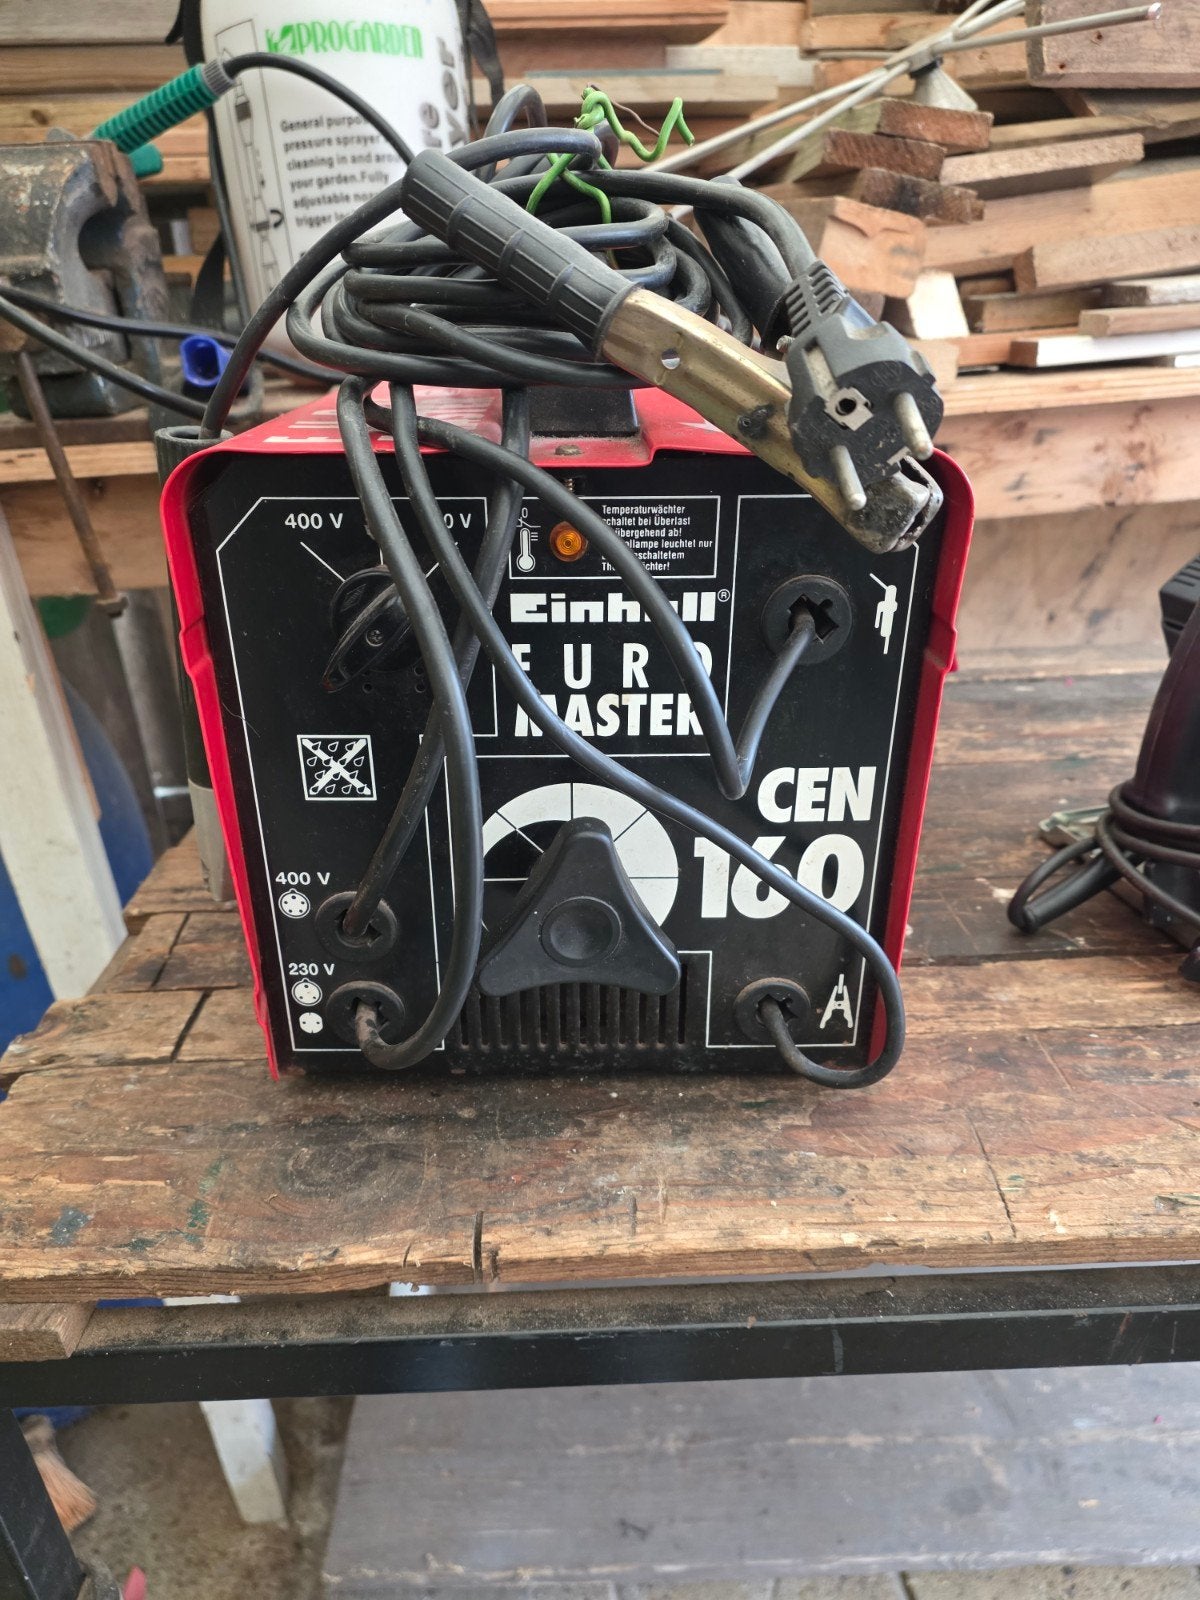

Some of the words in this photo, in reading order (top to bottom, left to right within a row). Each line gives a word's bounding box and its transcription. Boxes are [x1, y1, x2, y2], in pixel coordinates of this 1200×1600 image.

[296, 20, 423, 59] PROGARDEN
[281, 116, 324, 132] General
[284, 137, 333, 154] pressure
[287, 157, 334, 171] cleaning
[336, 154, 348, 164] in
[350, 153, 372, 164] and
[290, 179, 314, 193] your
[293, 192, 350, 209] adjustable
[295, 213, 332, 228] trigger
[602, 504, 686, 516] Temperaturwächter
[284, 513, 323, 530] 400
[330, 513, 343, 529] V
[459, 513, 472, 529] V
[638, 516, 652, 526] bei
[654, 514, 691, 526] Überlast
[668, 528, 682, 537] ab!
[661, 540, 696, 548] leuchtet
[757, 766, 877, 824] CEN
[275, 871, 312, 886] 400
[317, 872, 331, 885] V
[693, 833, 866, 919] 160
[288, 962, 319, 976] 230
[323, 963, 335, 976] V
